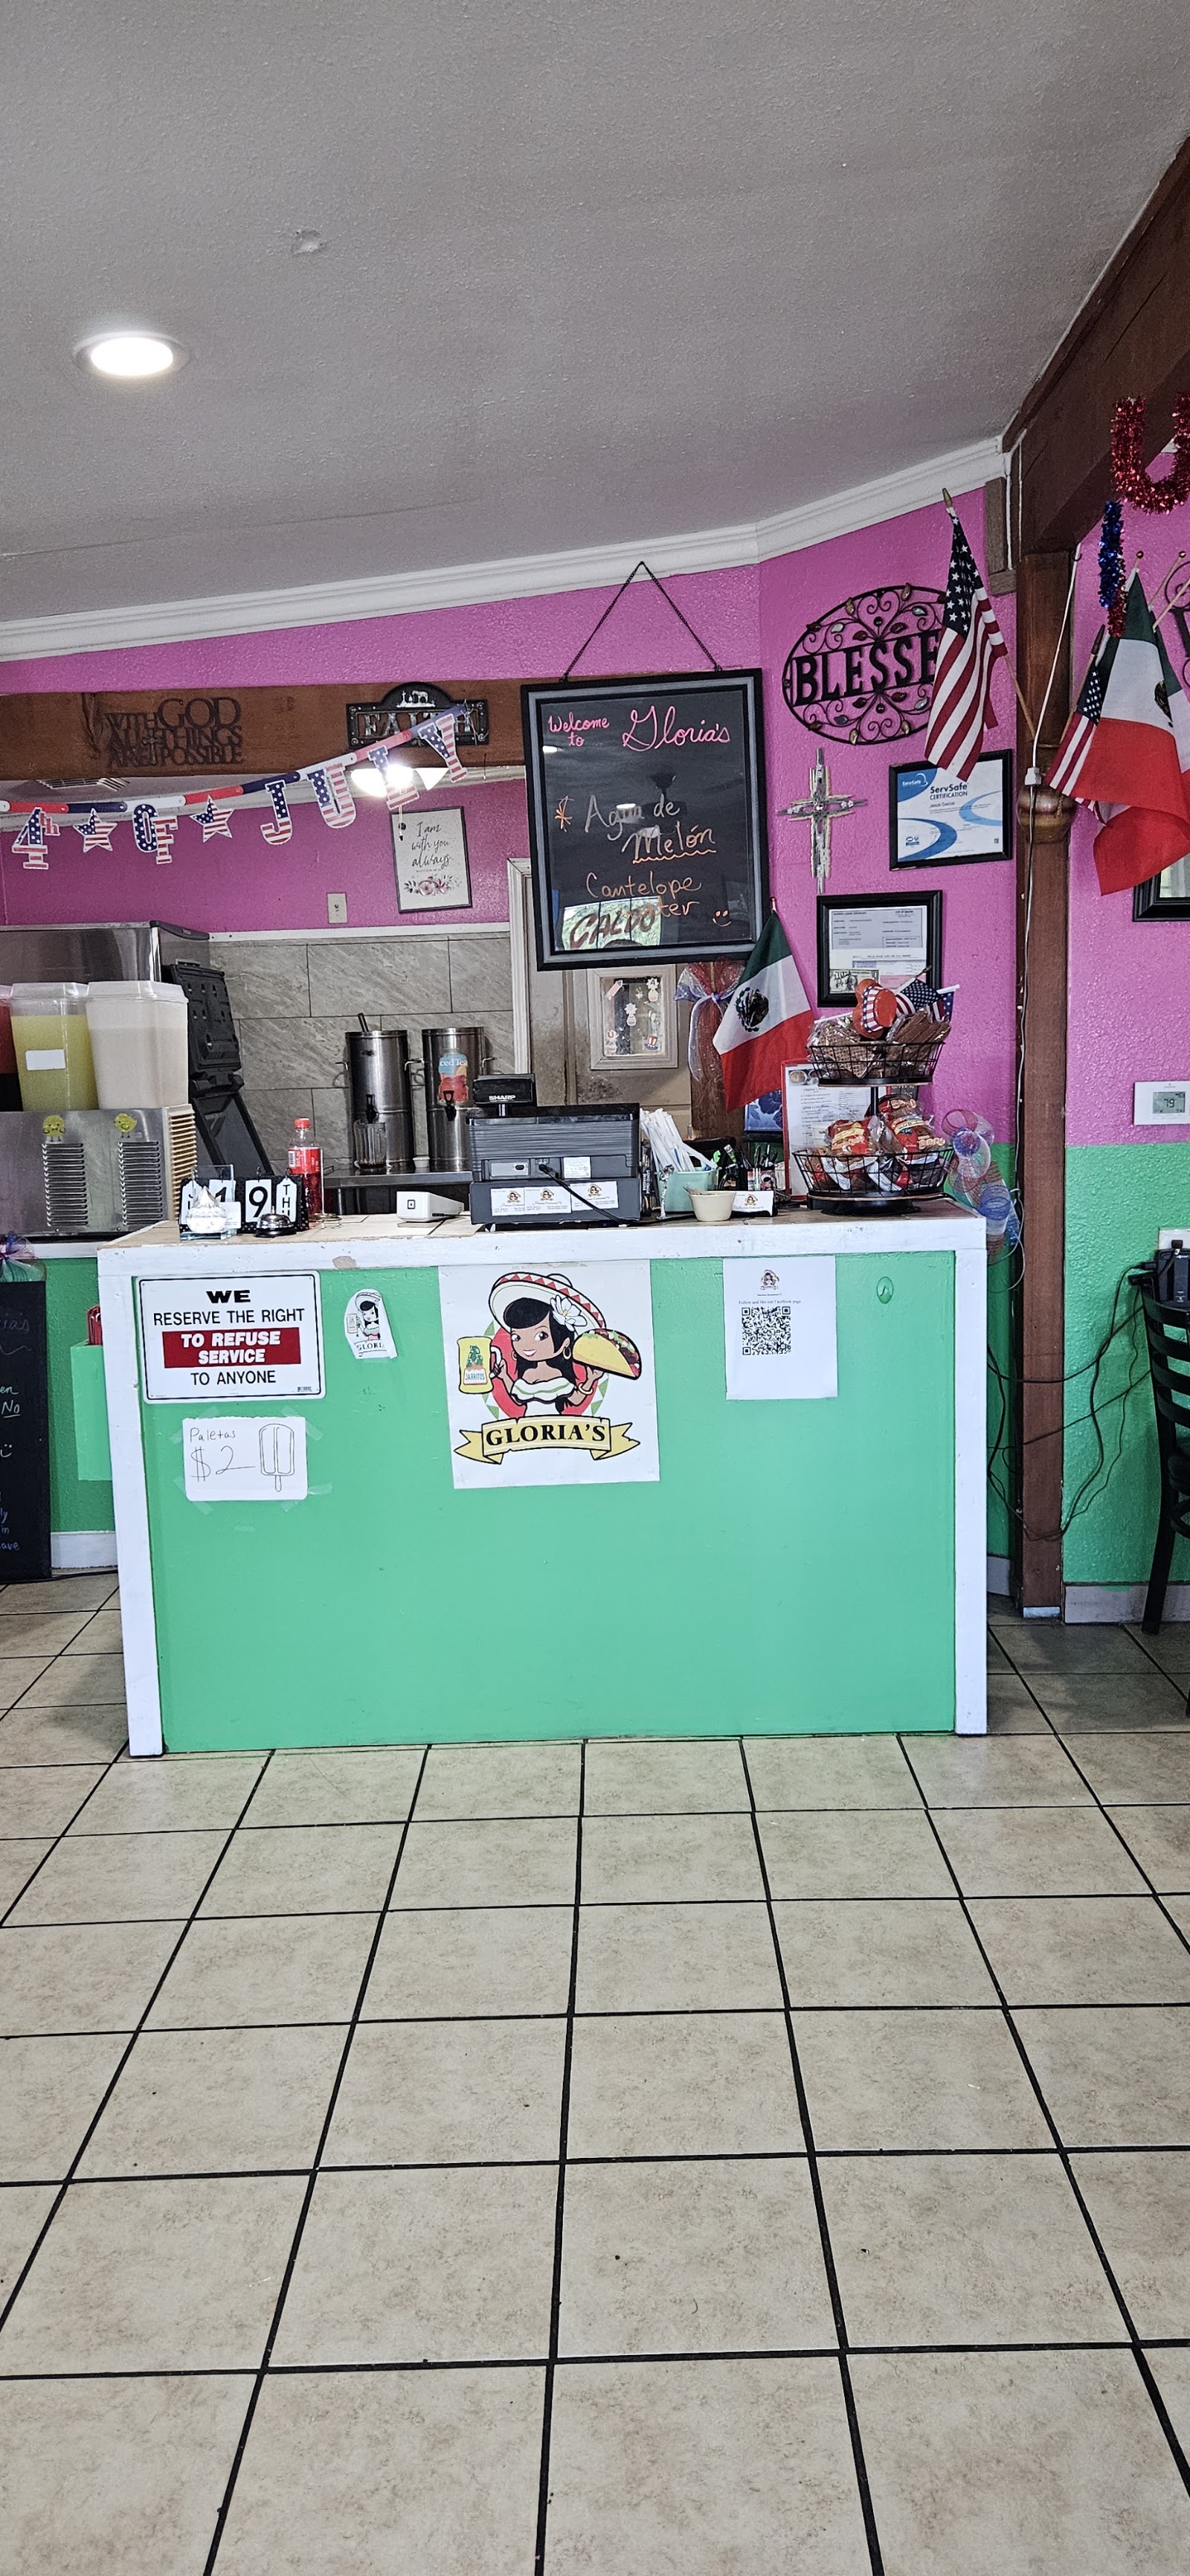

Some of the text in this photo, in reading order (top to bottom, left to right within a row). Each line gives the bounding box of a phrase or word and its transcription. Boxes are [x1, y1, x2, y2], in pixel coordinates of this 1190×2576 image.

[796, 632, 939, 706] BLESSE
[158, 696, 242, 730] GOD
[157, 725, 242, 747] THINGS
[548, 705, 731, 752] Welcome Gloria's
[567, 732, 585, 747] to
[158, 744, 244, 766] POSSIBLE
[132, 804, 178, 864] OF
[260, 713, 468, 846] JULY
[930, 782, 967, 794] ServSafe
[930, 791, 968, 800] CERTIFICATION
[585, 793, 681, 841] Agua de
[416, 822, 442, 837] I am
[411, 834, 449, 853] with you
[622, 820, 716, 861] Melón
[412, 852, 451, 870] always
[586, 870, 702, 899] Cantelope
[440, 1058, 454, 1067] ced
[1164, 1098, 1175, 1108] 79
[206, 1290, 251, 1303] WE
[154, 1308, 305, 1326] RESERVE THE RIGHT
[181, 1331, 281, 1348] TO REFUSE
[356, 1342, 384, 1351] GLORI
[198, 1349, 266, 1364] SERVICE
[190, 1370, 277, 1385] TO ANYONE
[1, 1399, 21, 1415] No
[190, 1427, 237, 1442] Paletas
[486, 1422, 607, 1446] GLORIA'S
